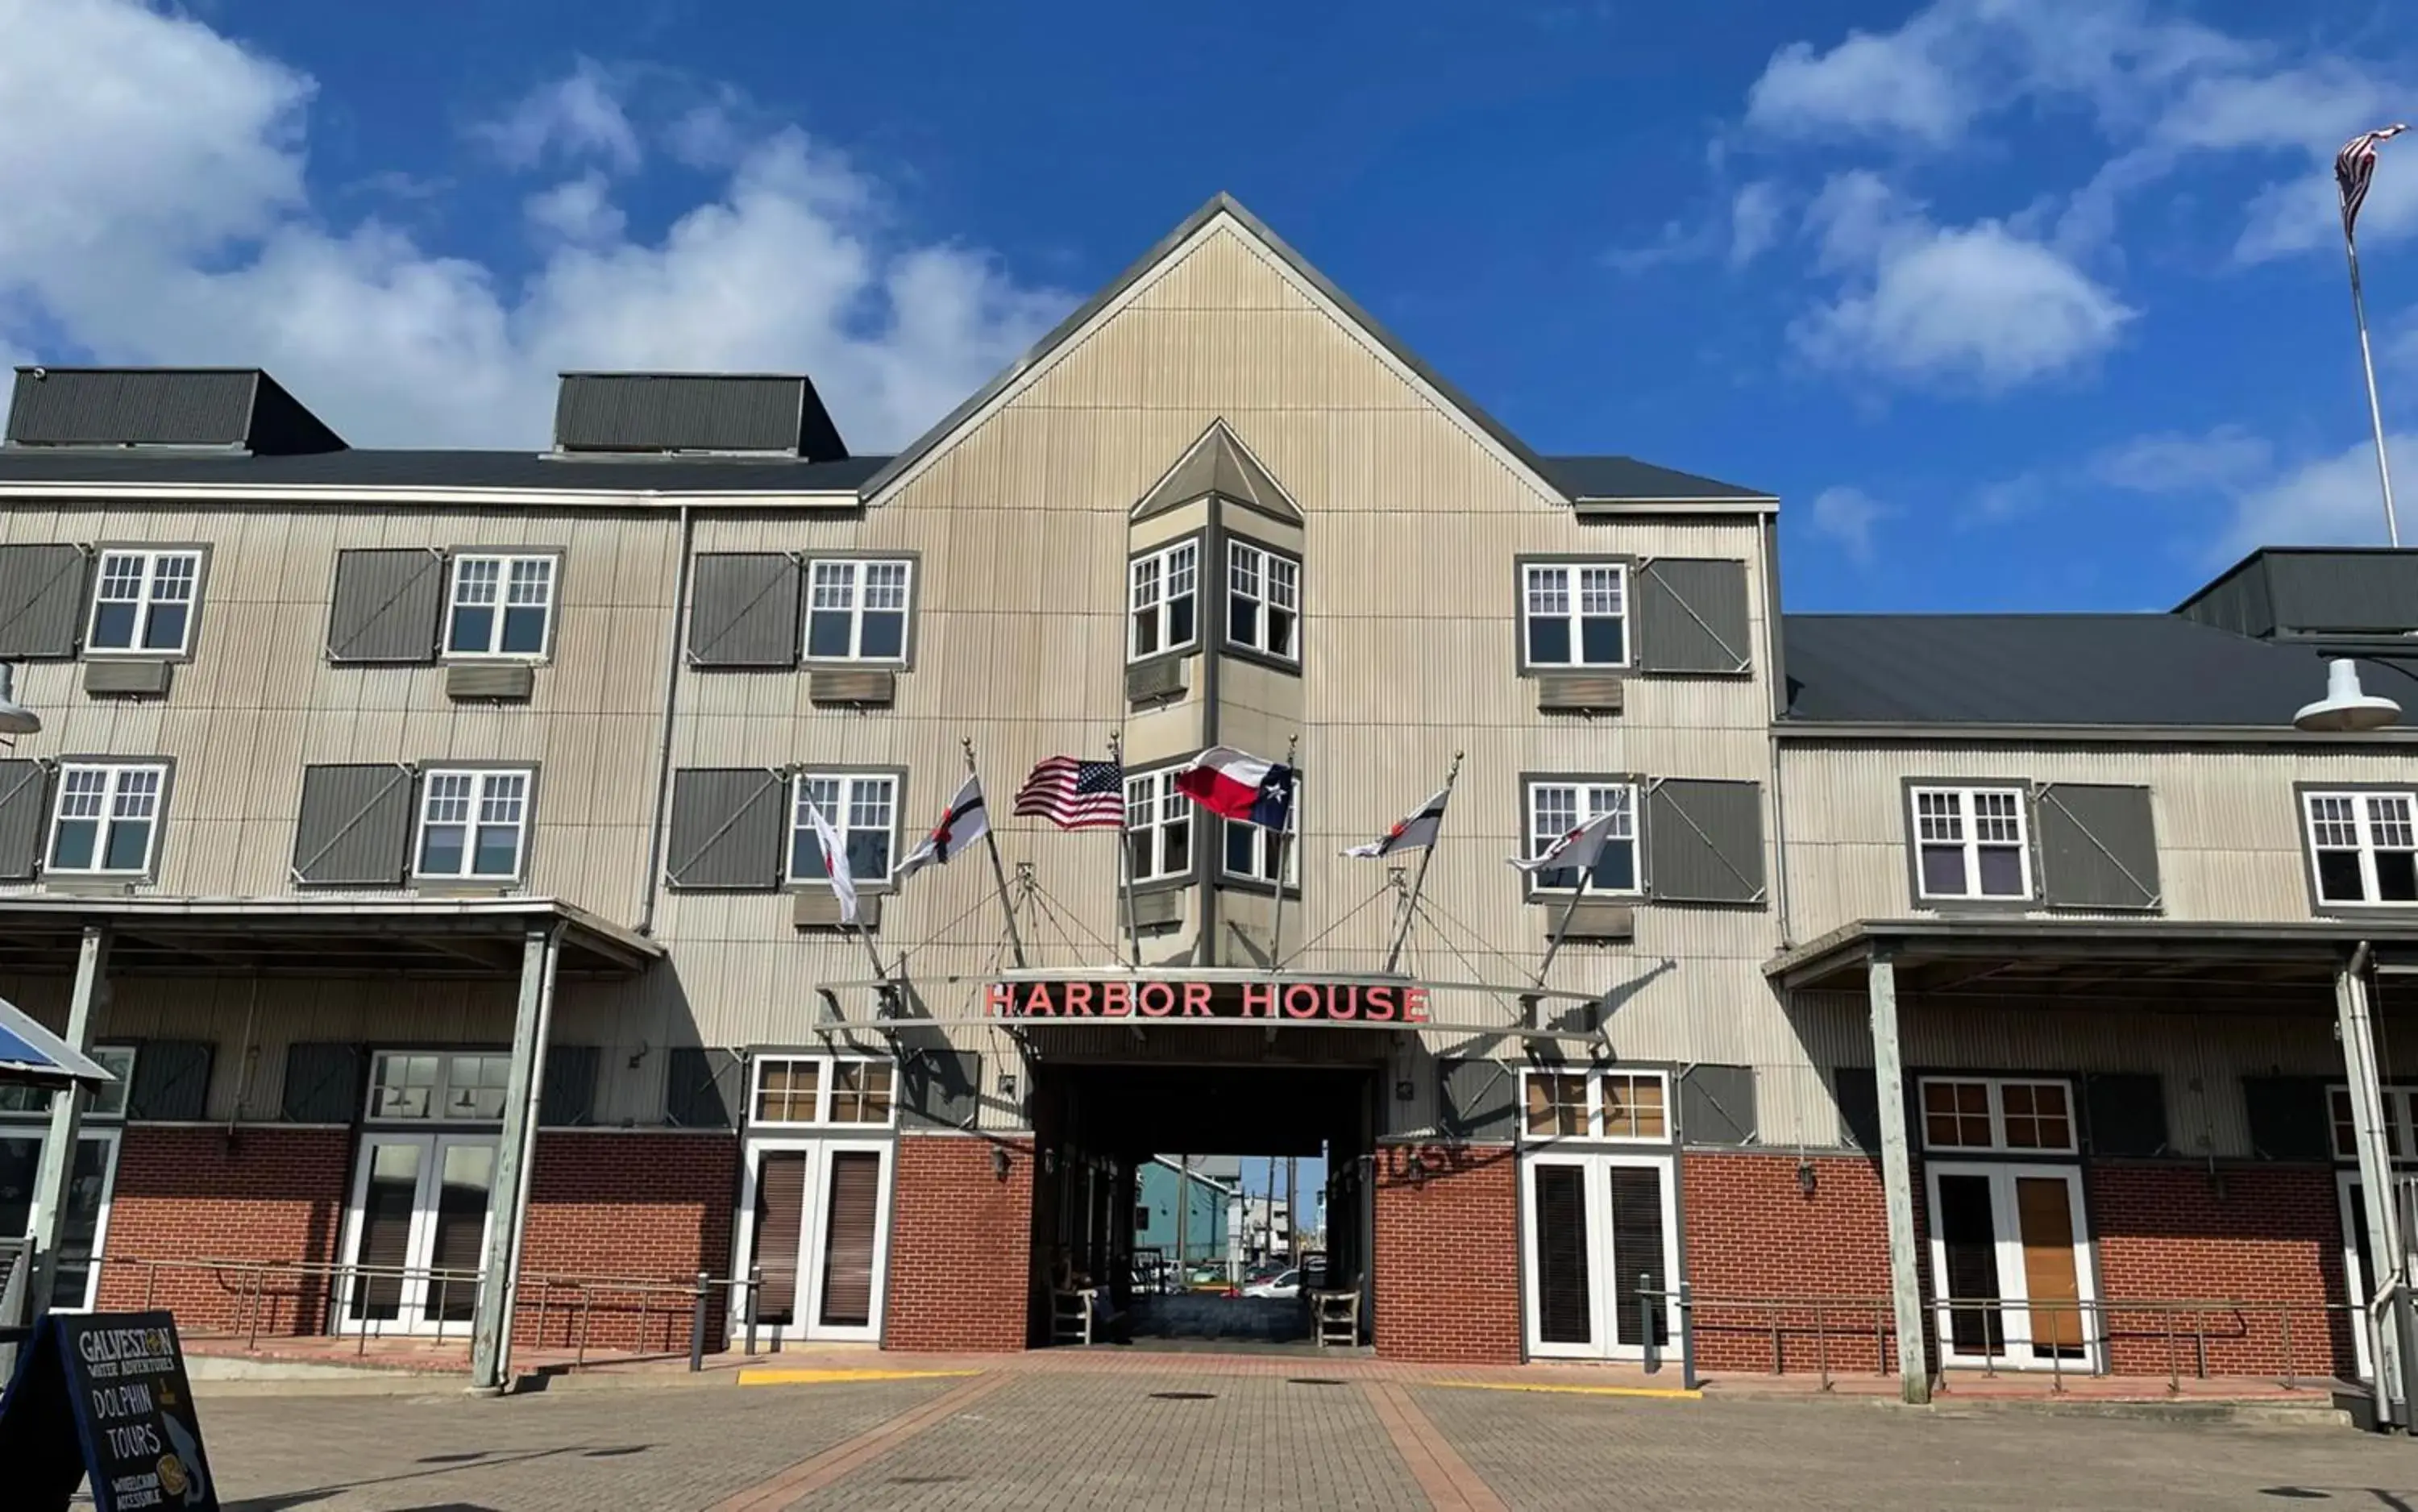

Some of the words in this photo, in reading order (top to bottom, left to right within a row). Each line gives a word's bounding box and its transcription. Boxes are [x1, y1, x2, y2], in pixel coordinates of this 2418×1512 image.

[985, 982, 1215, 1019] HARBOR
[1243, 982, 1431, 1022] HOUSE
[79, 1328, 174, 1362] GALVESTON
[92, 1383, 154, 1419] DOLPHIN
[106, 1423, 161, 1460] TOURS
